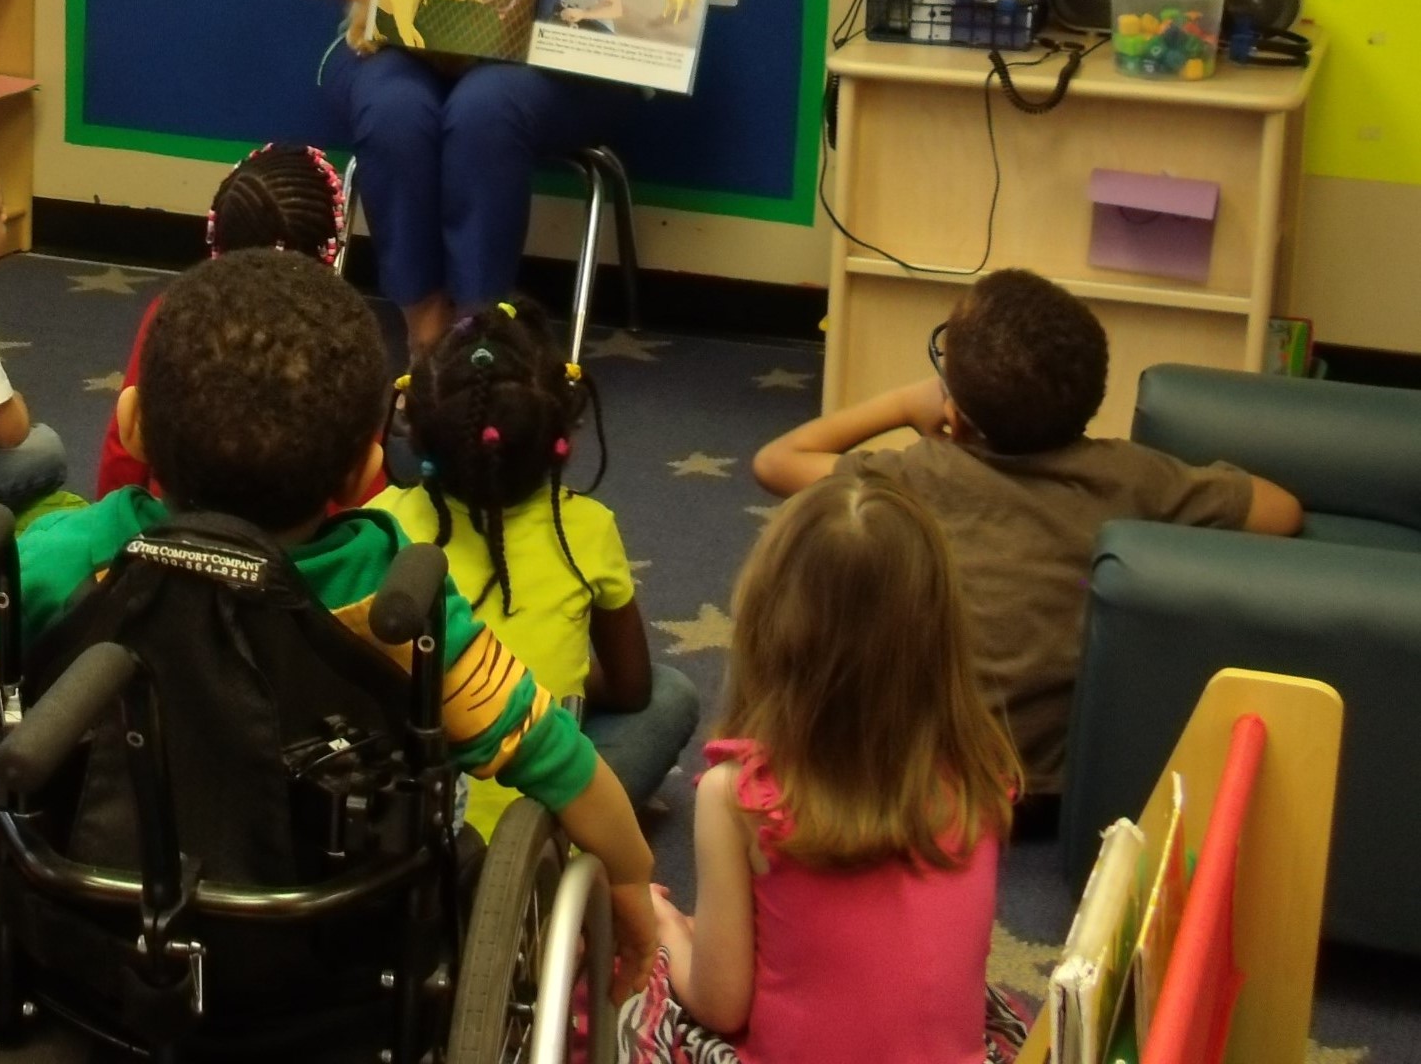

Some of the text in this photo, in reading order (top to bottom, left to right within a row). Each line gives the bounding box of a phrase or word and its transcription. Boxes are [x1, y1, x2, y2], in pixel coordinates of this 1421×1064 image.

[138, 542, 260, 573] THE COMFORT COMPANY
